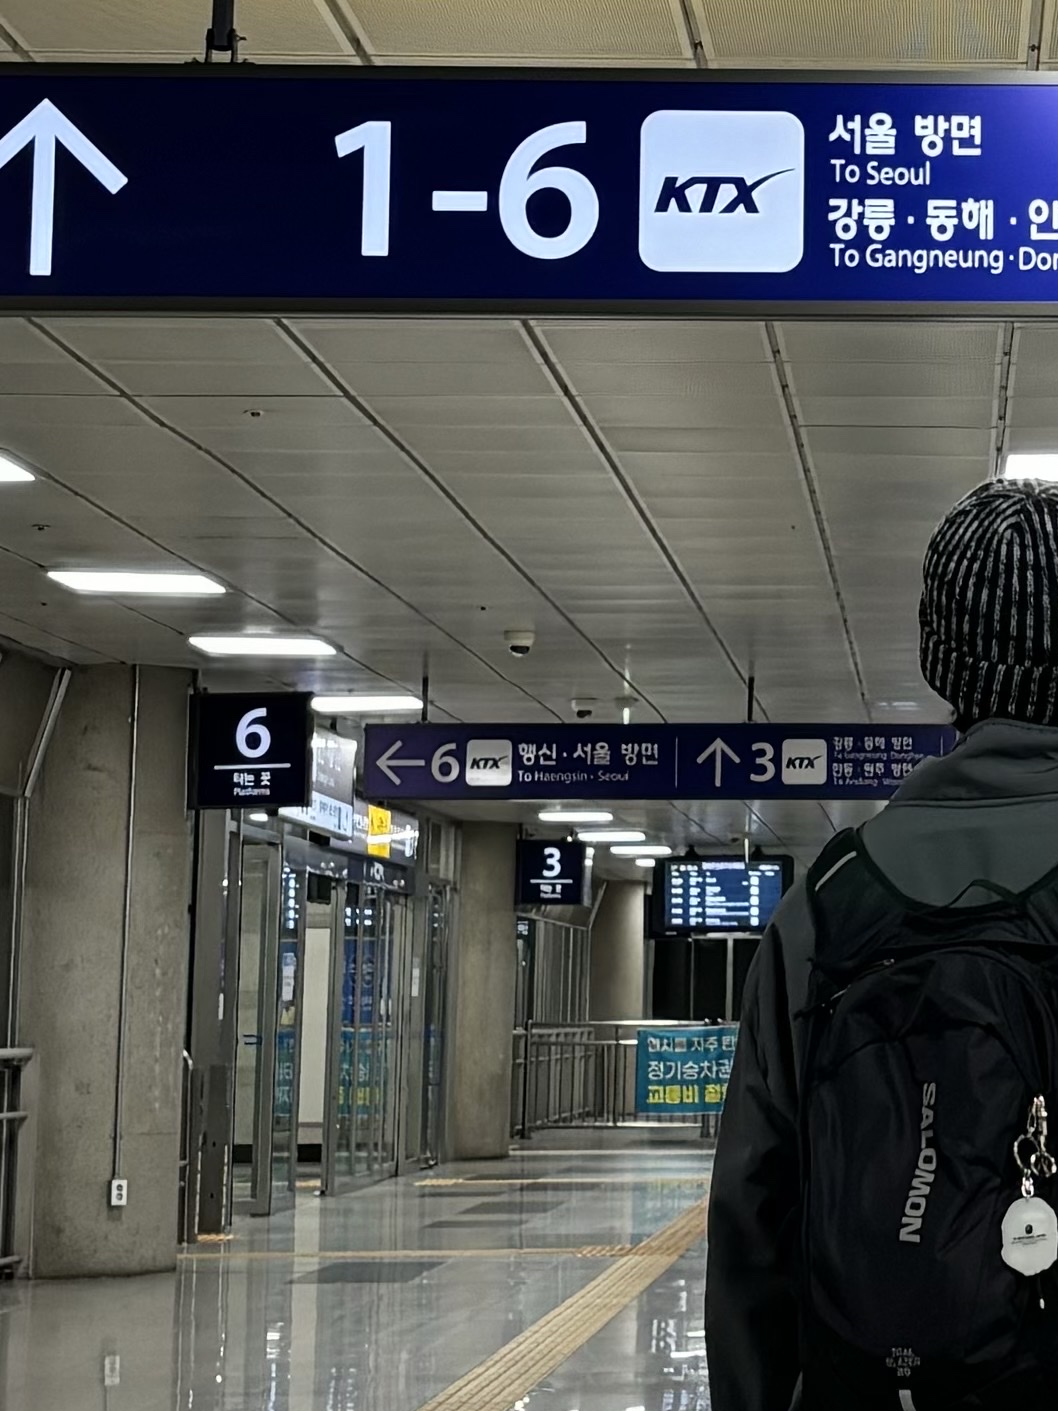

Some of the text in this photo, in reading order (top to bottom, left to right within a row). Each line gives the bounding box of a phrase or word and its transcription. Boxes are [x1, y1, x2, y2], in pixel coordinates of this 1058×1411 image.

[828, 112, 982, 157] 서울 방면
[334, 120, 600, 260] 1-6
[654, 168, 795, 214] KTX
[830, 158, 931, 186] To Seoul
[828, 197, 896, 241] 강릉
[925, 198, 994, 242] 동해
[830, 243, 860, 268] To
[235, 707, 271, 759] 6
[431, 743, 460, 783] 6
[470, 755, 508, 770] KTX
[518, 742, 659, 766] 행신 서울 방면
[750, 742, 776, 783] 3
[785, 755, 823, 770] KTX
[518, 770, 532, 782] To
[542, 846, 562, 878] 3
[899, 1081, 937, 1244] SALOMON
